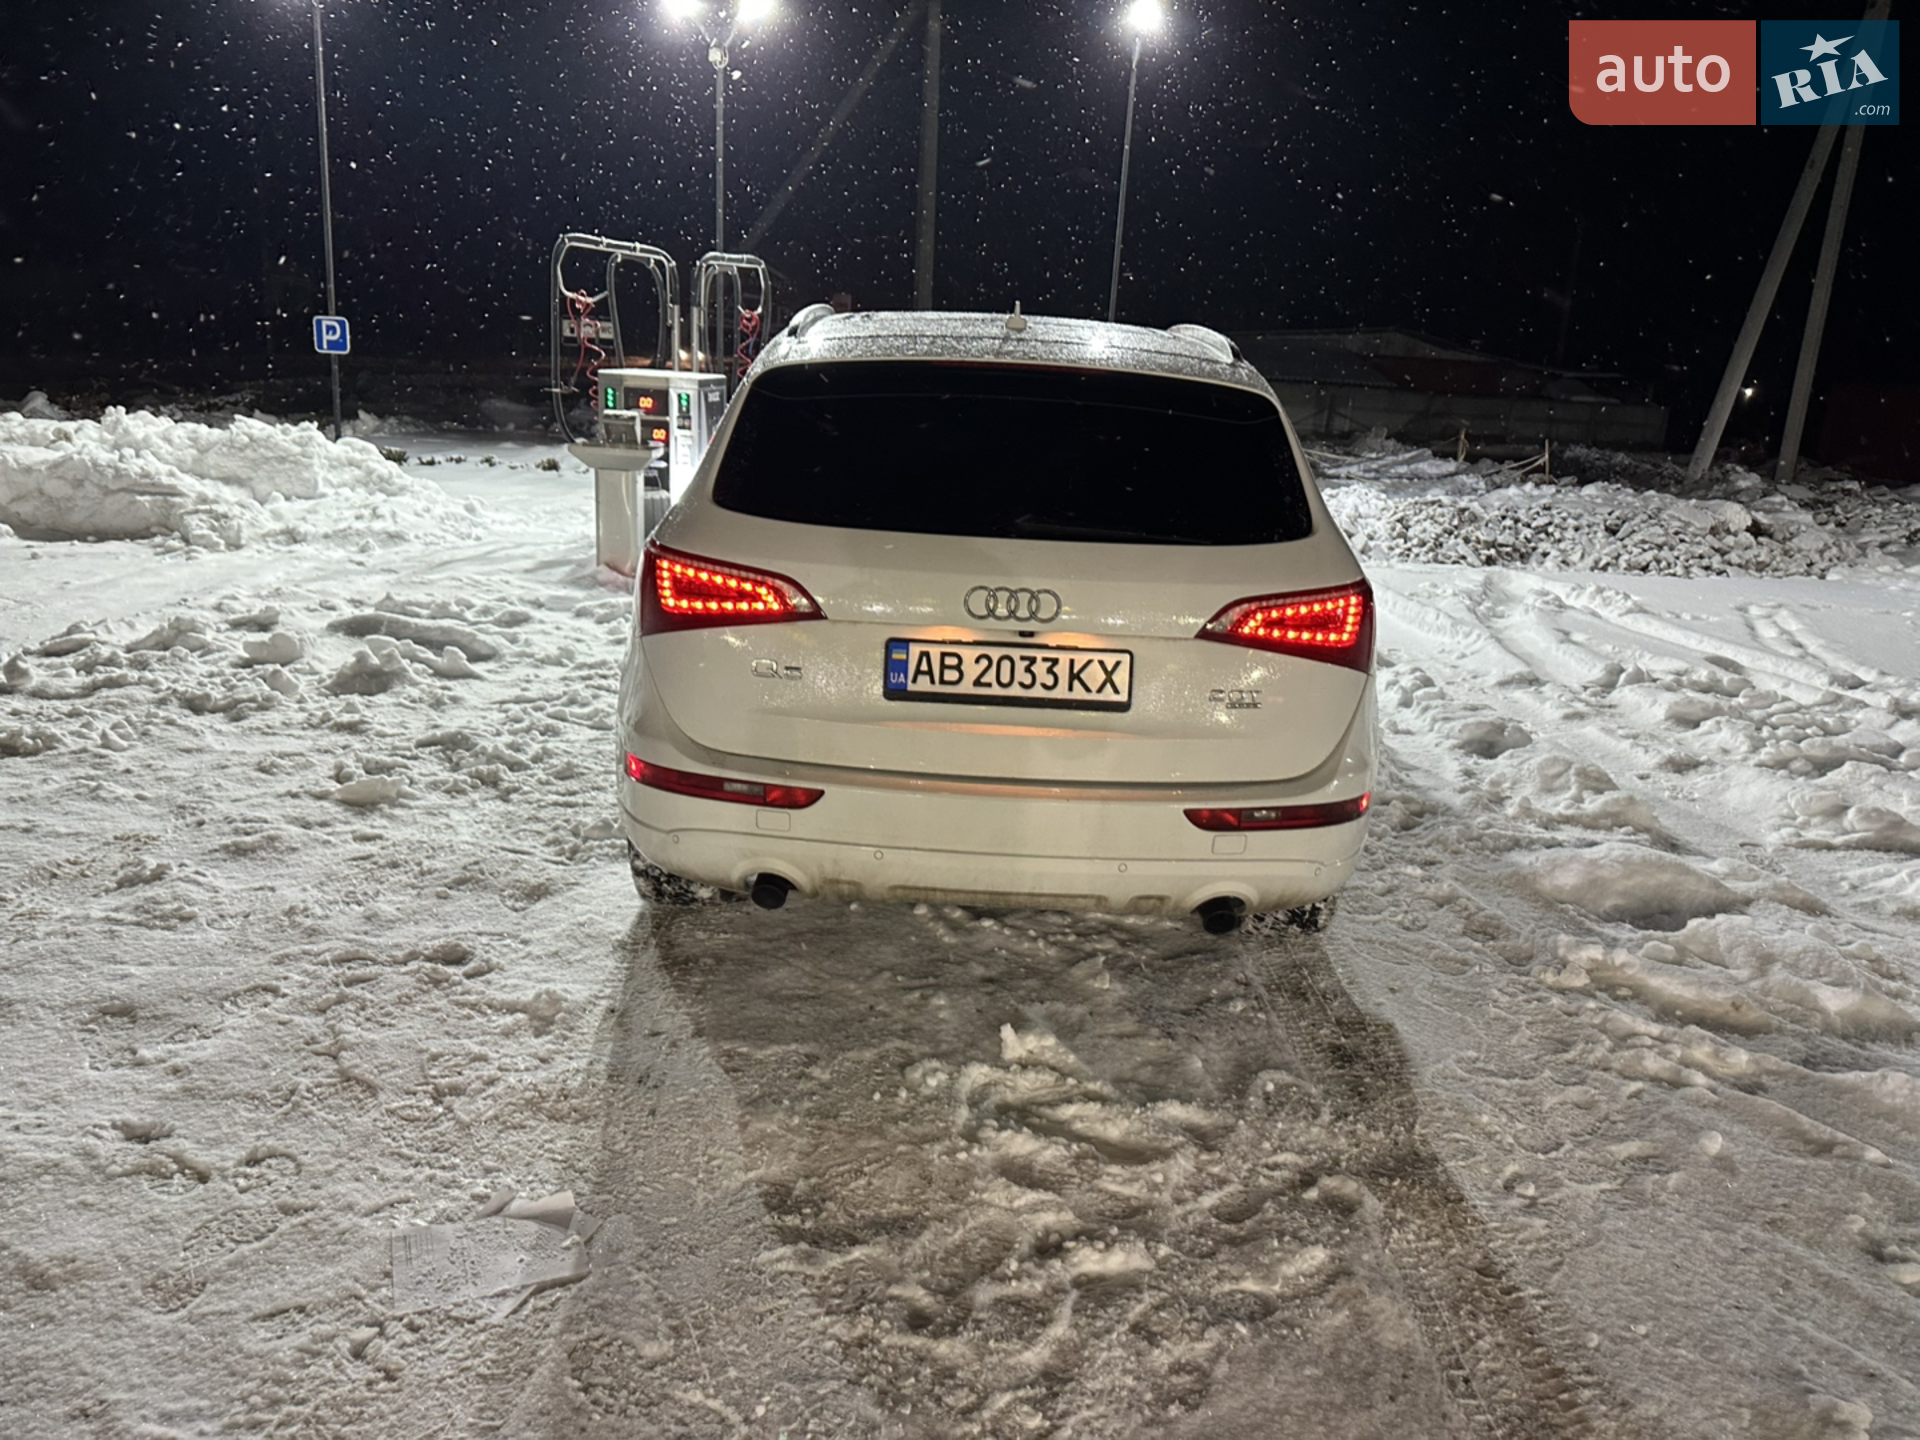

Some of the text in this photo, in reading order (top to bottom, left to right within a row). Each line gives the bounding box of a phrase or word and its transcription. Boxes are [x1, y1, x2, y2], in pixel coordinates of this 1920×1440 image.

[321, 320, 341, 349] P
[890, 672, 906, 685] UA
[911, 650, 1122, 695] AB 2033 KX
